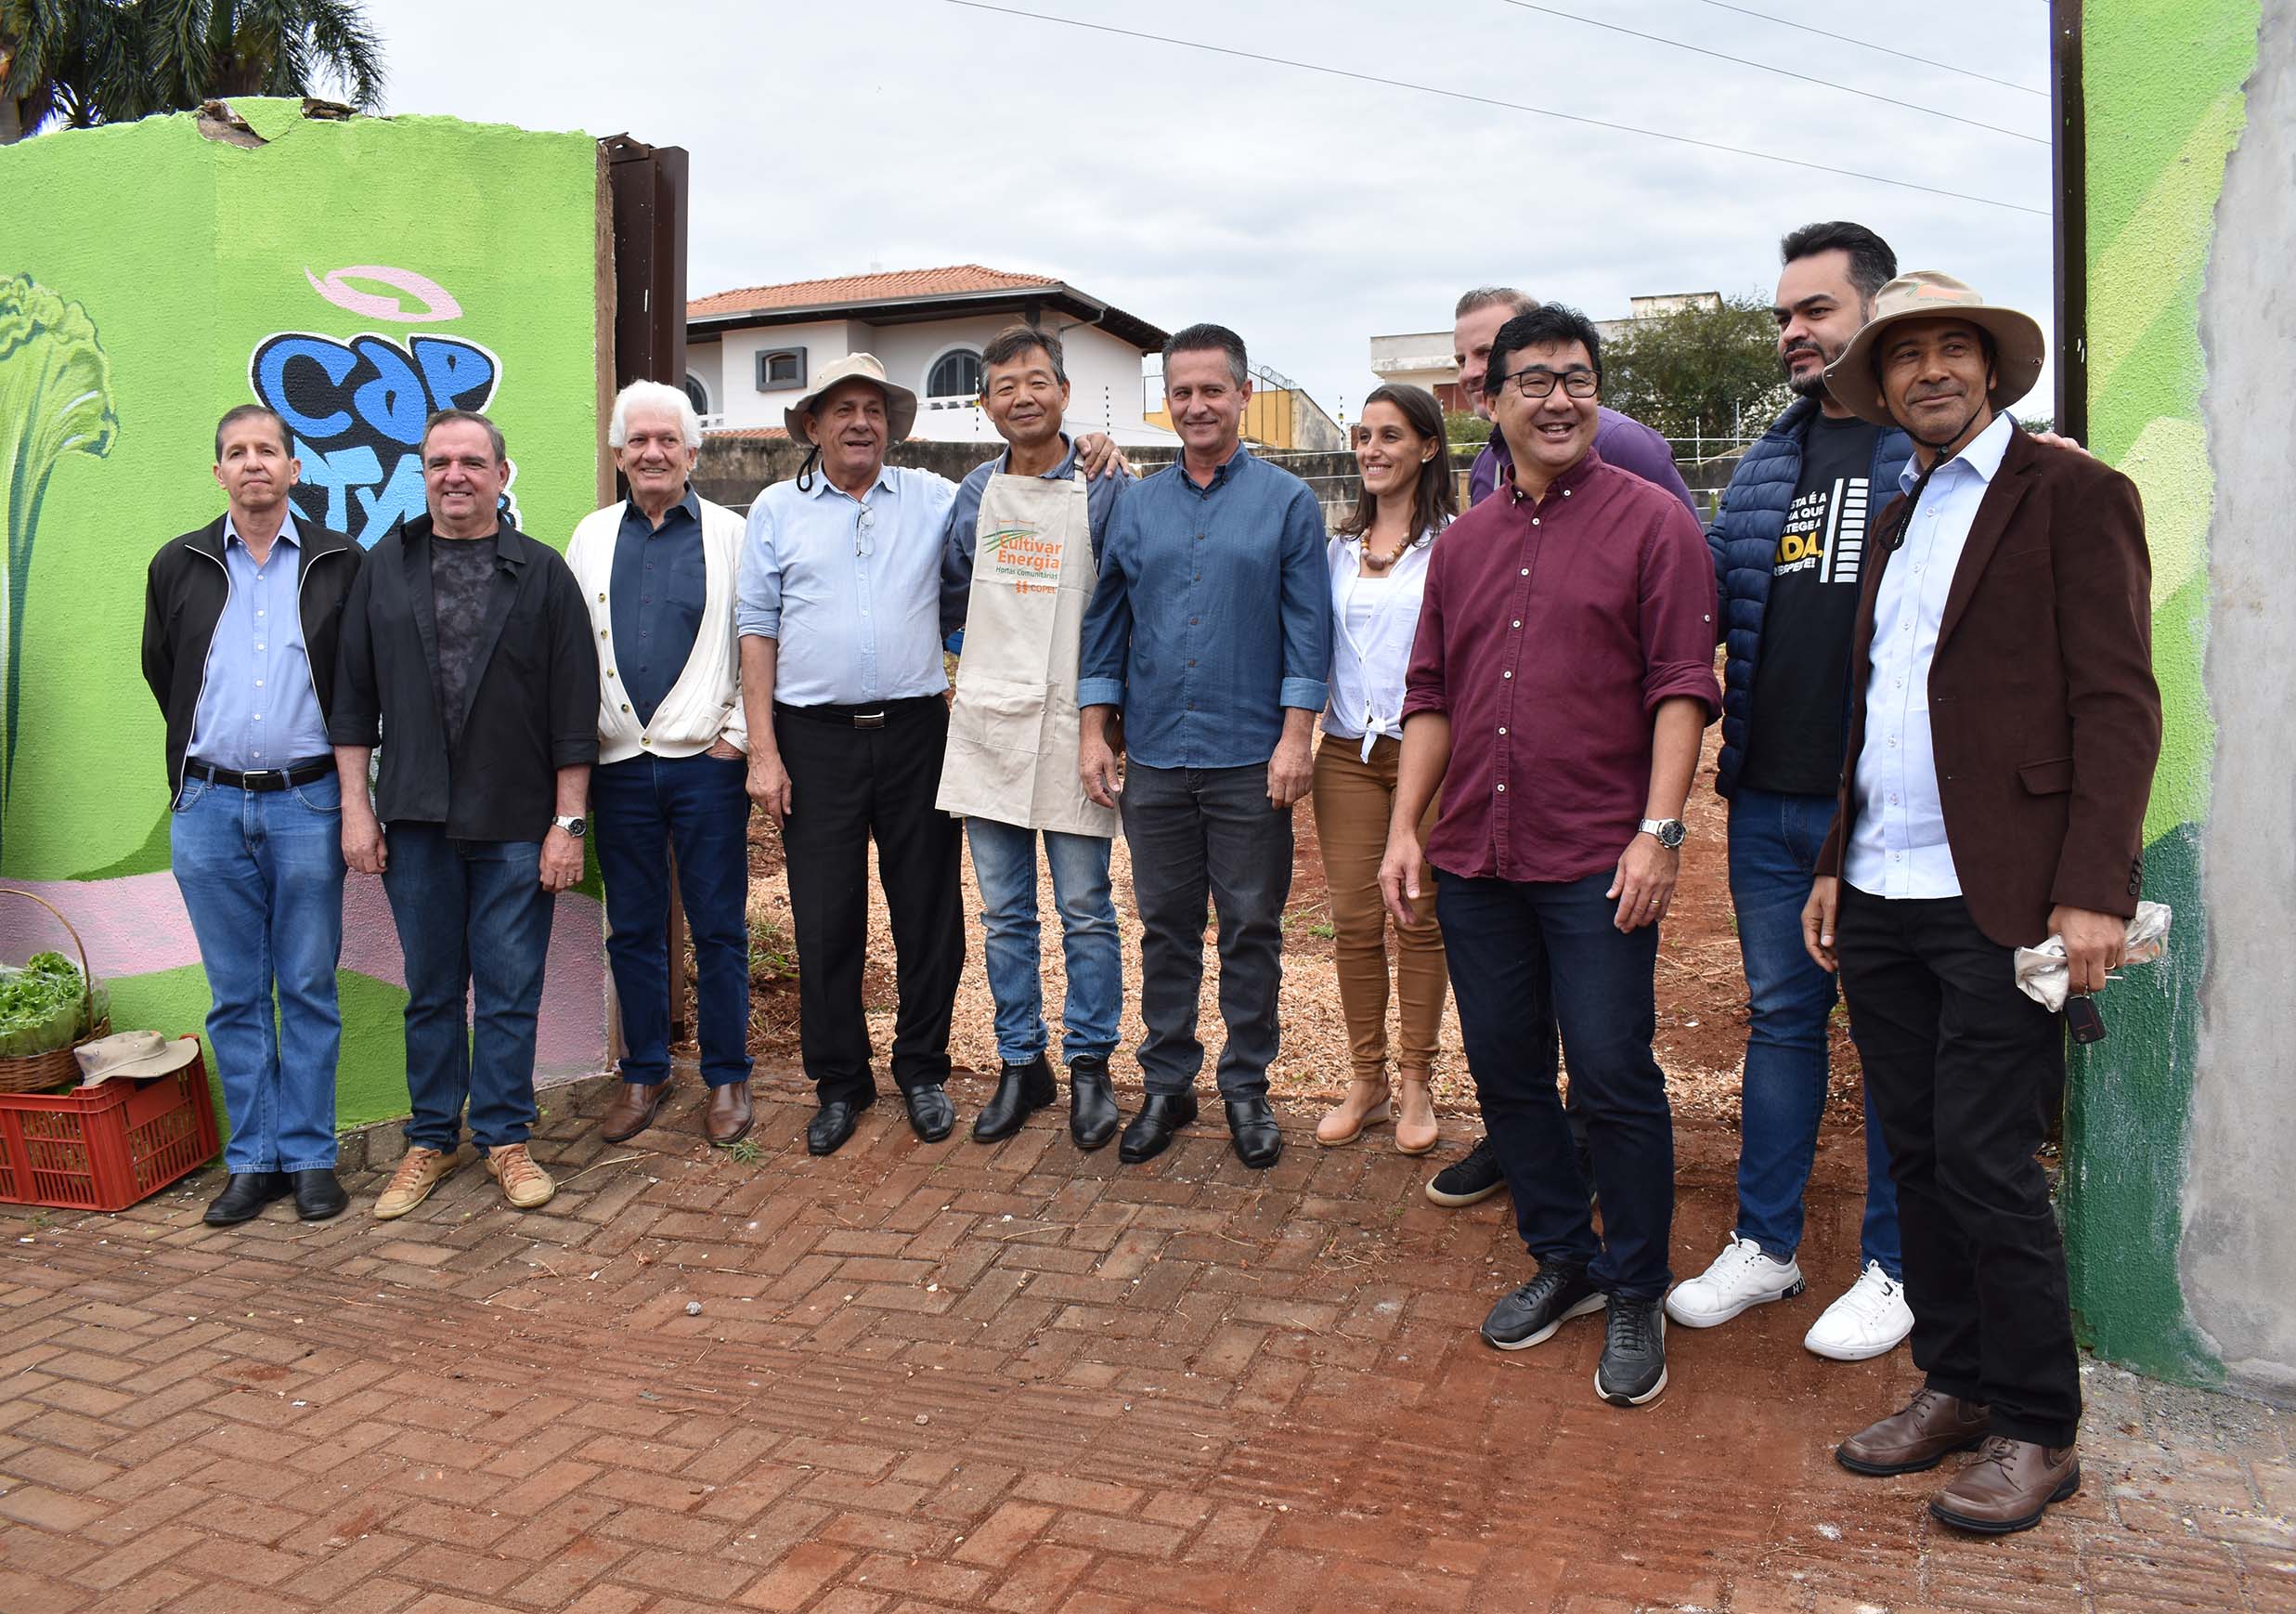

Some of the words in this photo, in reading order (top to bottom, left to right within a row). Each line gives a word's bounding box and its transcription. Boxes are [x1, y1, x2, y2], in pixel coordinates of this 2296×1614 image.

[1809, 491, 1817, 504] É
[1818, 492, 1827, 503] A
[1800, 505, 1825, 518] QUE
[1782, 520, 1815, 534] TEGE
[999, 535, 1062, 554] Cultivar
[997, 550, 1061, 570] Energia
[995, 566, 1016, 575] Hortas
[1031, 584, 1057, 594] COPEL
